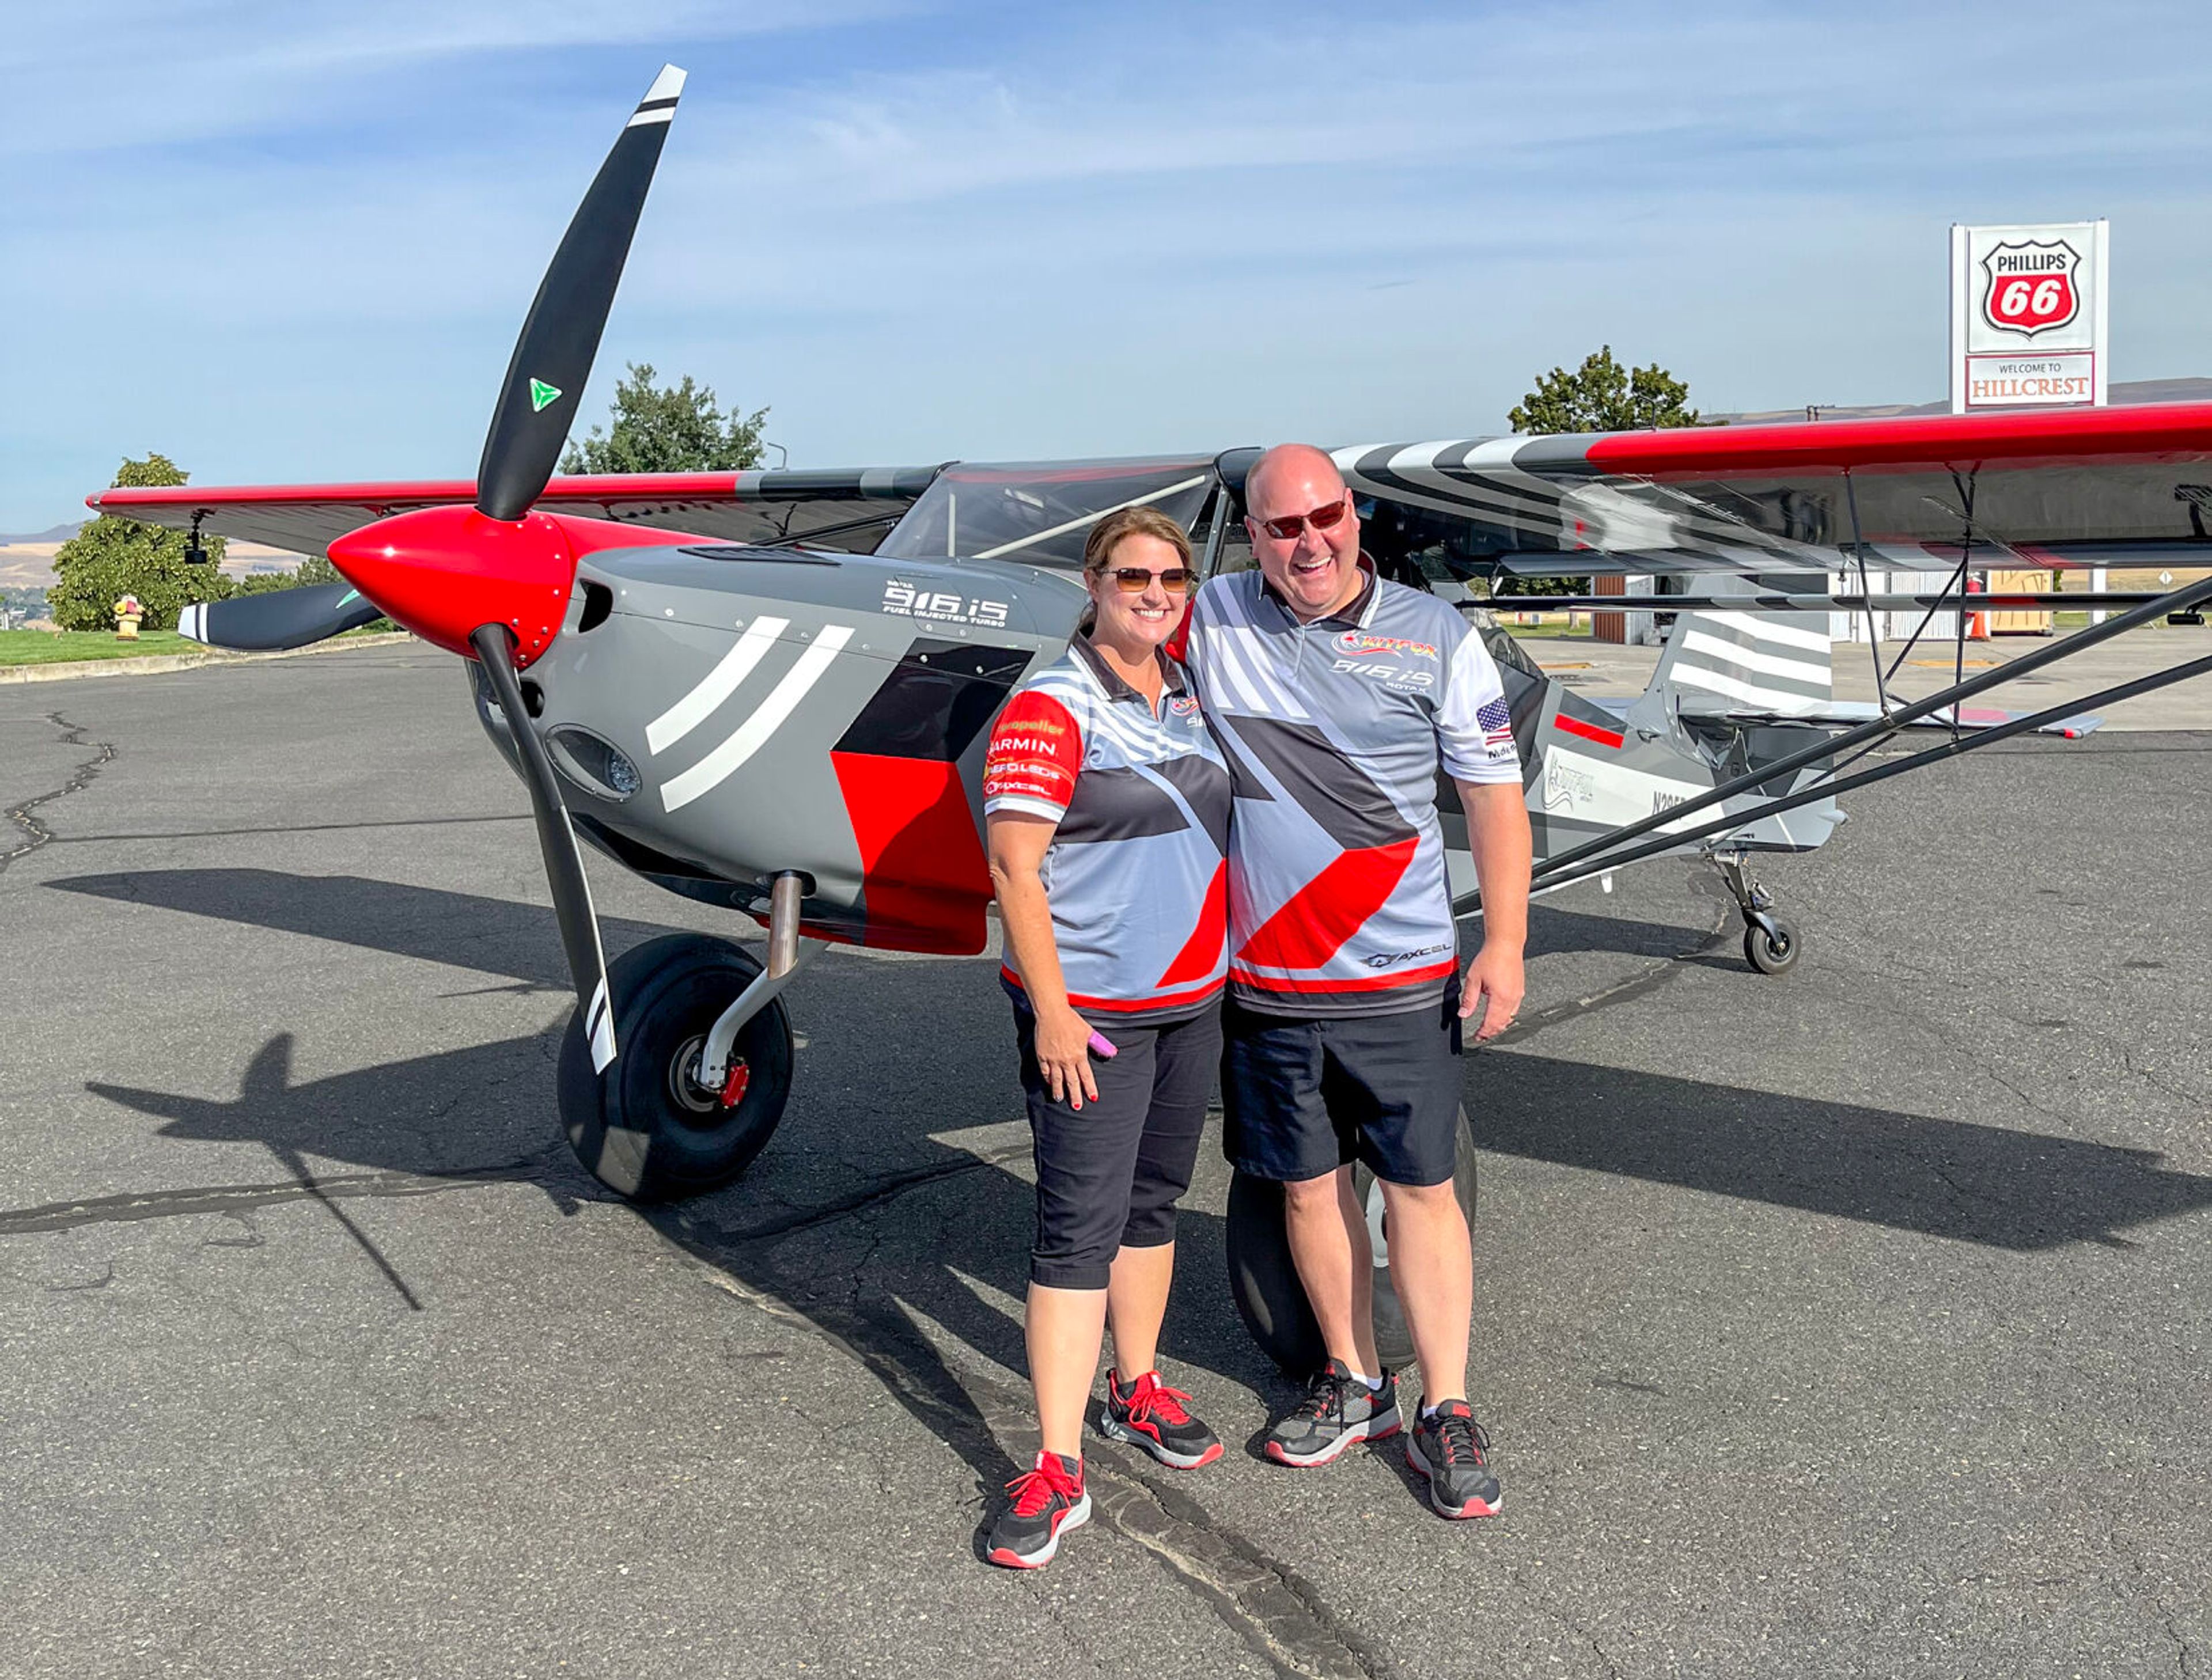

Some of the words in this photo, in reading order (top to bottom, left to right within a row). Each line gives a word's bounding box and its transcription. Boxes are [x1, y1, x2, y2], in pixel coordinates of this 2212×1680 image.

[1998, 253, 2067, 272] PHILLIPS
[2001, 279, 2062, 317] 66
[1999, 363, 2046, 374] WELCOME
[2048, 363, 2062, 373] TO
[1972, 377, 2089, 398] HILLCREST
[882, 587, 962, 615] 916
[883, 606, 912, 616] FUEL
[914, 610, 968, 623] INJECTED
[970, 617, 1005, 628] TURBO
[1361, 635, 1437, 658] KITFOX
[1328, 659, 1398, 680] 916
[1386, 682, 1426, 693] ROTAX
[1397, 943, 1452, 961] AXCEL
